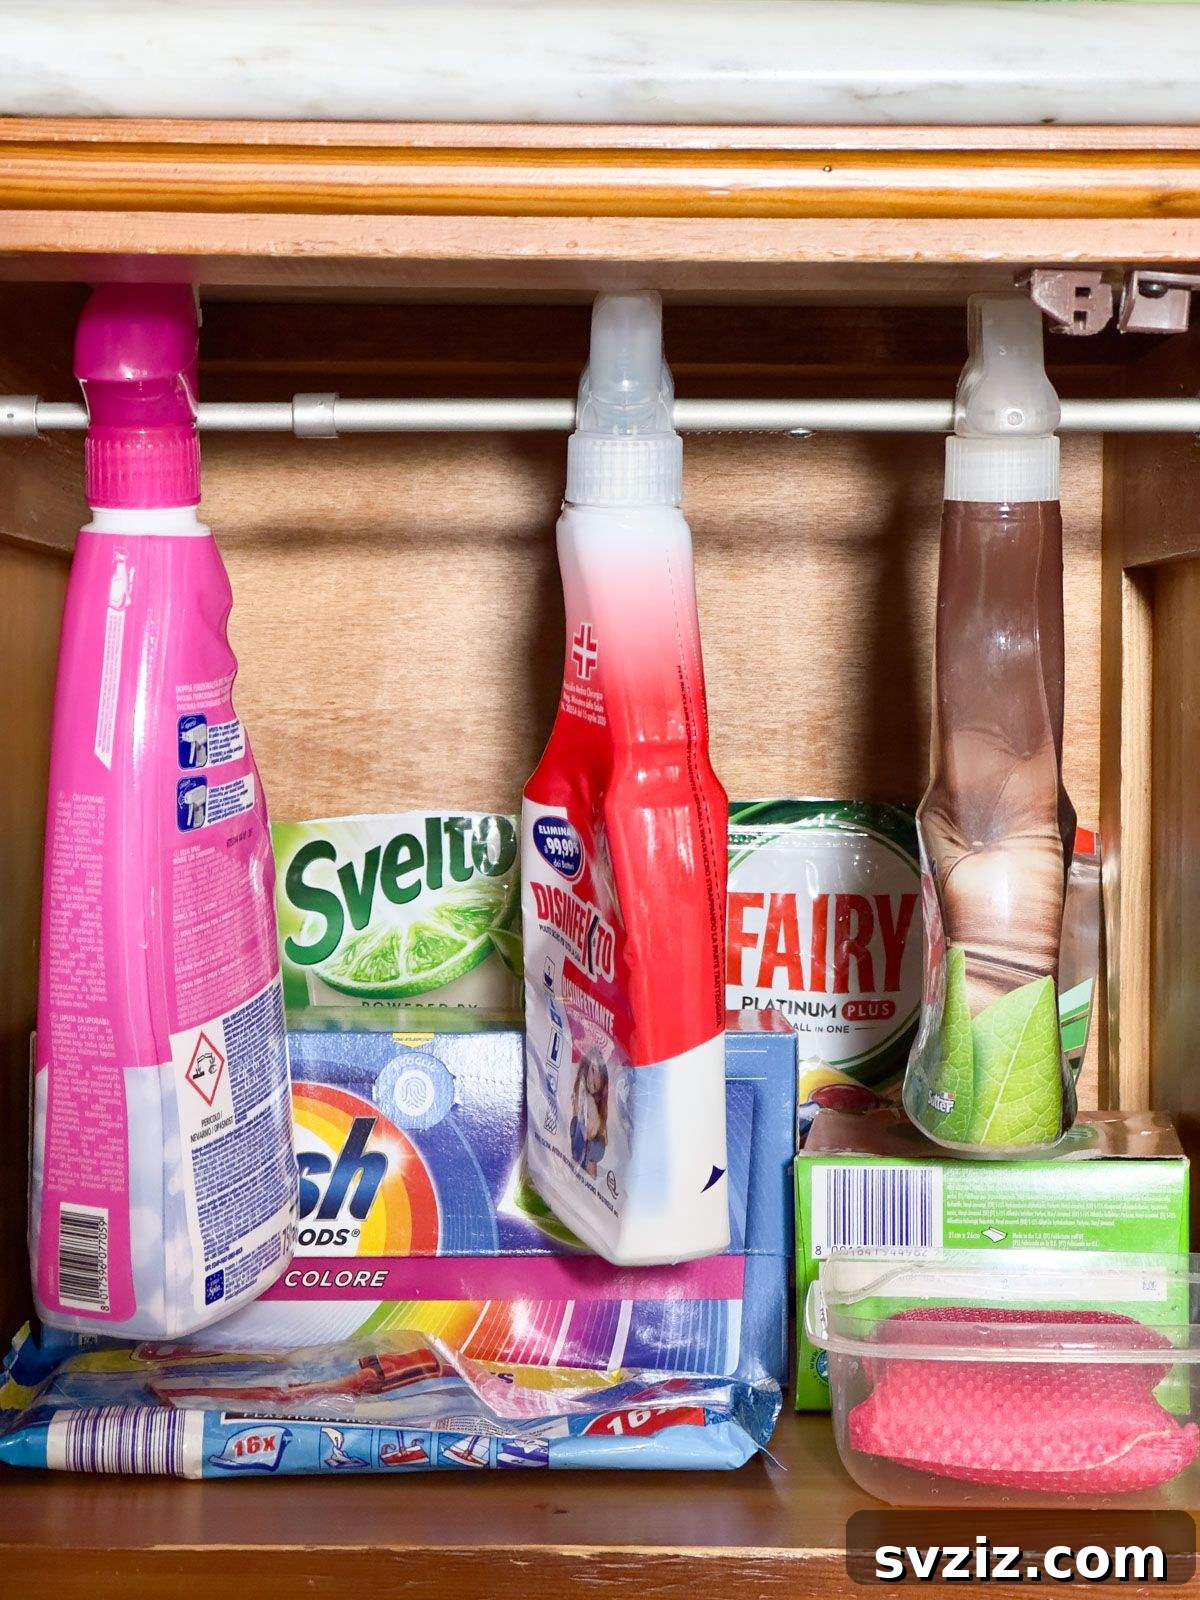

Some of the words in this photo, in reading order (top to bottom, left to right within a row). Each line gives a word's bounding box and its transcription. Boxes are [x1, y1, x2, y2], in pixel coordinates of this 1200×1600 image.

[538, 825, 572, 837] ELIMINA
[284, 815, 518, 966] Svelto
[706, 879, 717, 931] STRAPPANDO
[725, 891, 920, 994] FAIRY
[742, 996, 837, 1018] PLATINUM
[847, 1003, 890, 1017] PLUS
[793, 1022, 812, 1032] ALL
[826, 1025, 850, 1034] ONE
[201, 1112, 220, 1128] PERICOLO
[190, 1128, 212, 1143] NEVARNO
[296, 1115, 389, 1222] sh
[99, 1220, 107, 1259] 077059
[298, 1229, 361, 1246] ODS®
[815, 1246, 822, 1255] 8
[99, 1264, 109, 1301] 017596
[284, 1270, 389, 1288] COLORE
[607, 1407, 672, 1435] 16
[234, 1435, 277, 1457] 16x
